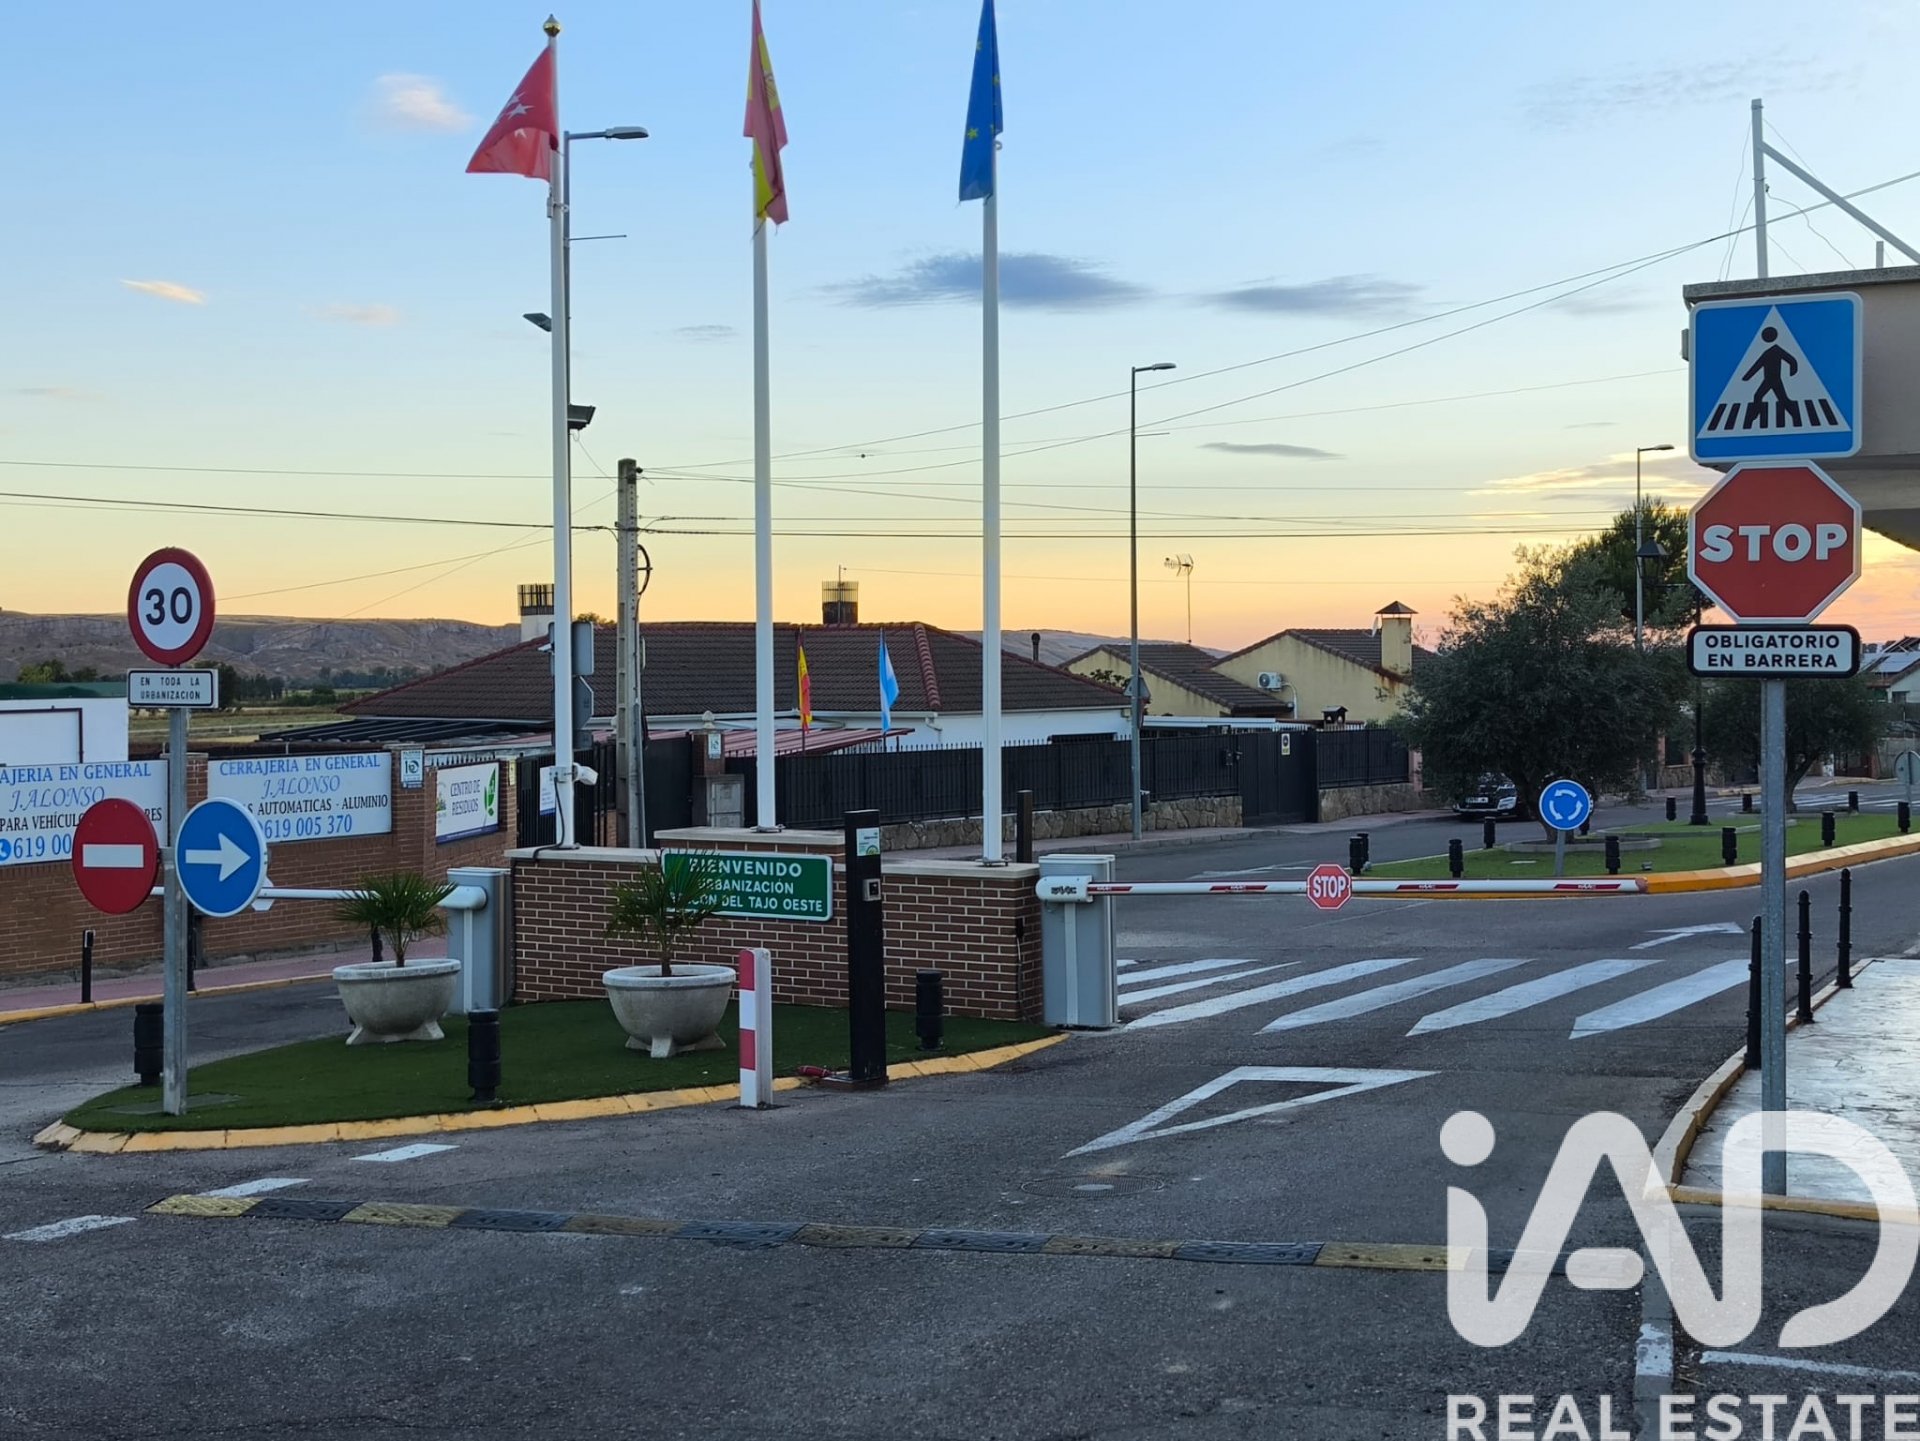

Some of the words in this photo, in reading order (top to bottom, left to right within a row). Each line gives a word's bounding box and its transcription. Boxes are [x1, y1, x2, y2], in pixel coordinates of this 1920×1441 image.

[1699, 523, 1848, 563] STOP
[145, 586, 193, 625] 30
[1705, 634, 1840, 649] OBLIGATORIO
[1708, 653, 1734, 667] EN
[1745, 653, 1838, 667] BARRERA
[141, 677, 150, 686] EN
[160, 677, 181, 686] TODA
[190, 677, 200, 686] LA
[60, 765, 79, 781] EN
[84, 763, 151, 779] GENERAL
[219, 759, 299, 776] CERRAJERIA
[305, 757, 321, 771] EN
[325, 754, 381, 770] GENERAL
[257, 798, 332, 816] AUTOMATICAS
[341, 794, 388, 810] ALUMINIO
[0, 816, 29, 832] PARA
[264, 819, 291, 839] 619
[296, 816, 322, 837] 005
[327, 814, 352, 834] 370
[13, 835, 45, 859] 619
[1312, 875, 1347, 898] STOP
[722, 895, 743, 908] DEL
[748, 896, 778, 910] TAJO
[783, 898, 823, 913] OESTE
